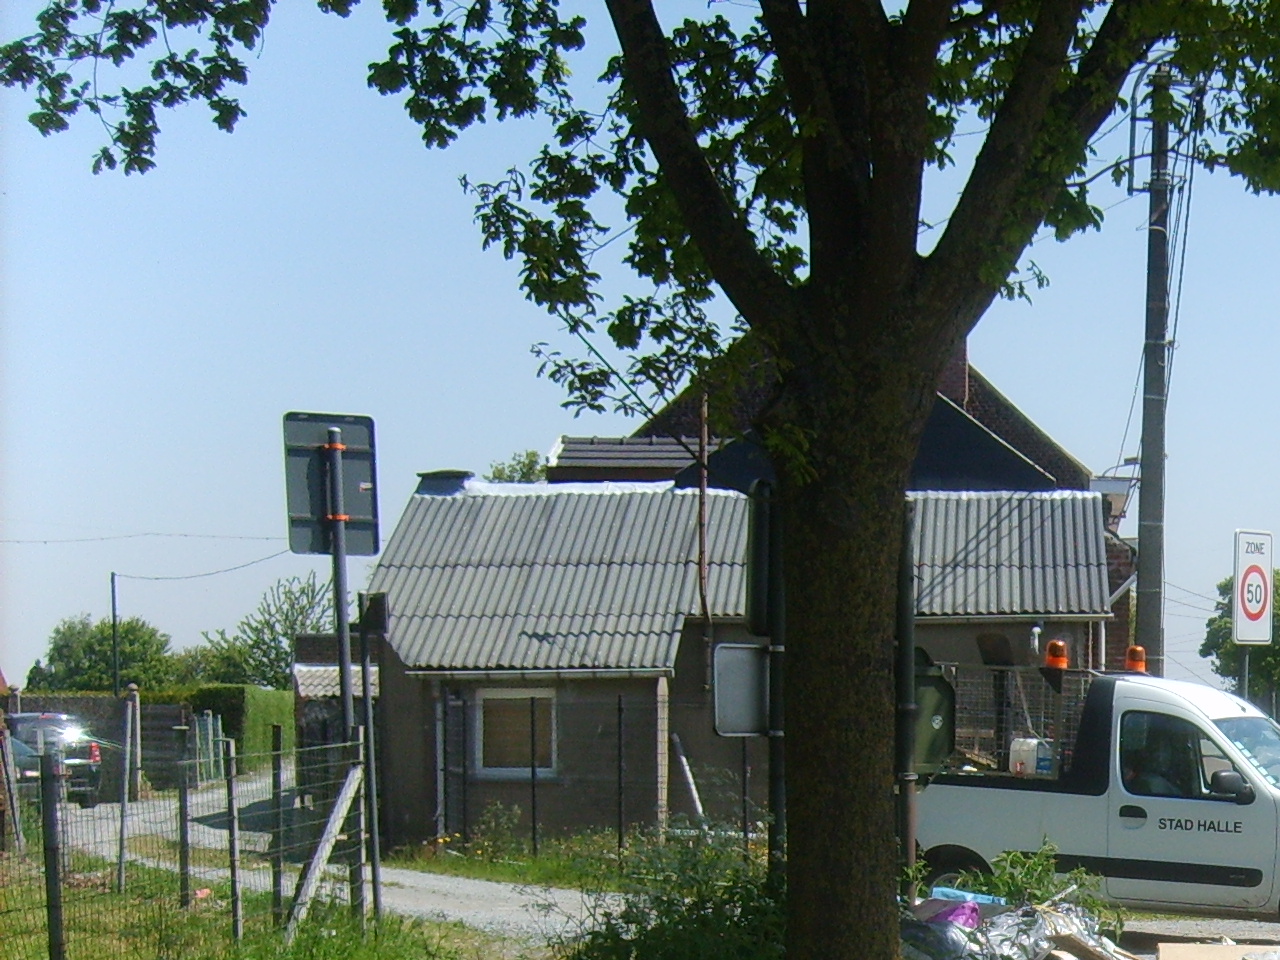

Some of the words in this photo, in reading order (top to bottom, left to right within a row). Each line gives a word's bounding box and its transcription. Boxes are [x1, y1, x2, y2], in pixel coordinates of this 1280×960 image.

[1245, 541, 1265, 554] ZONE
[1247, 583, 1262, 604] 50
[1158, 818, 1194, 831] STAD
[1197, 820, 1243, 833] HALLE
